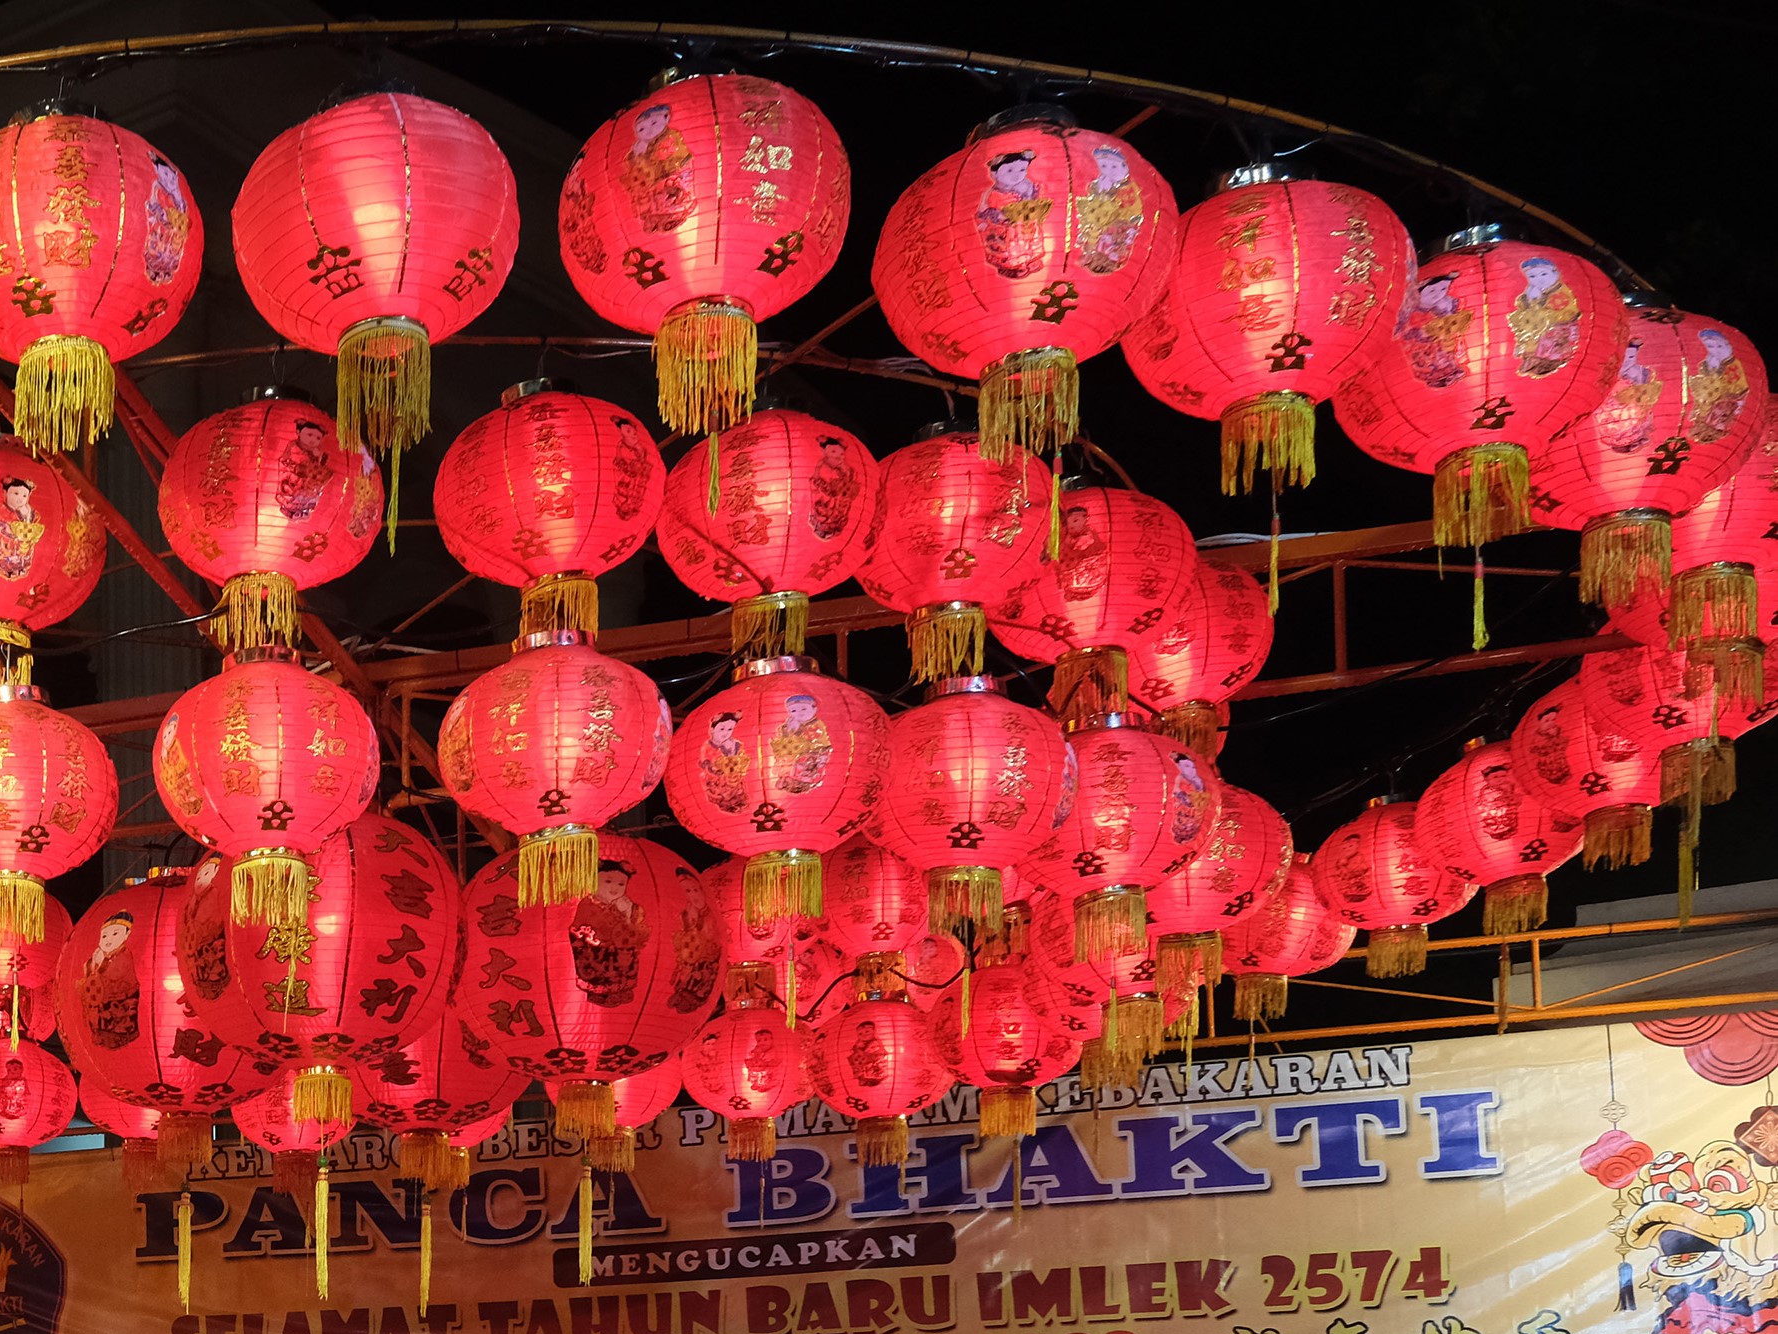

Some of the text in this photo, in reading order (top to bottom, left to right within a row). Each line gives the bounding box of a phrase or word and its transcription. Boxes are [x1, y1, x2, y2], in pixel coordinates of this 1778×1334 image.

[359, 826, 434, 1024] 大吉大利
[136, 1088, 1503, 1263] PANCA BHAKTI
[589, 1233, 918, 1280] MENGUCAPKAN
[975, 1257, 1234, 1326] IMLEK
[1259, 1246, 1456, 1313] 2574
